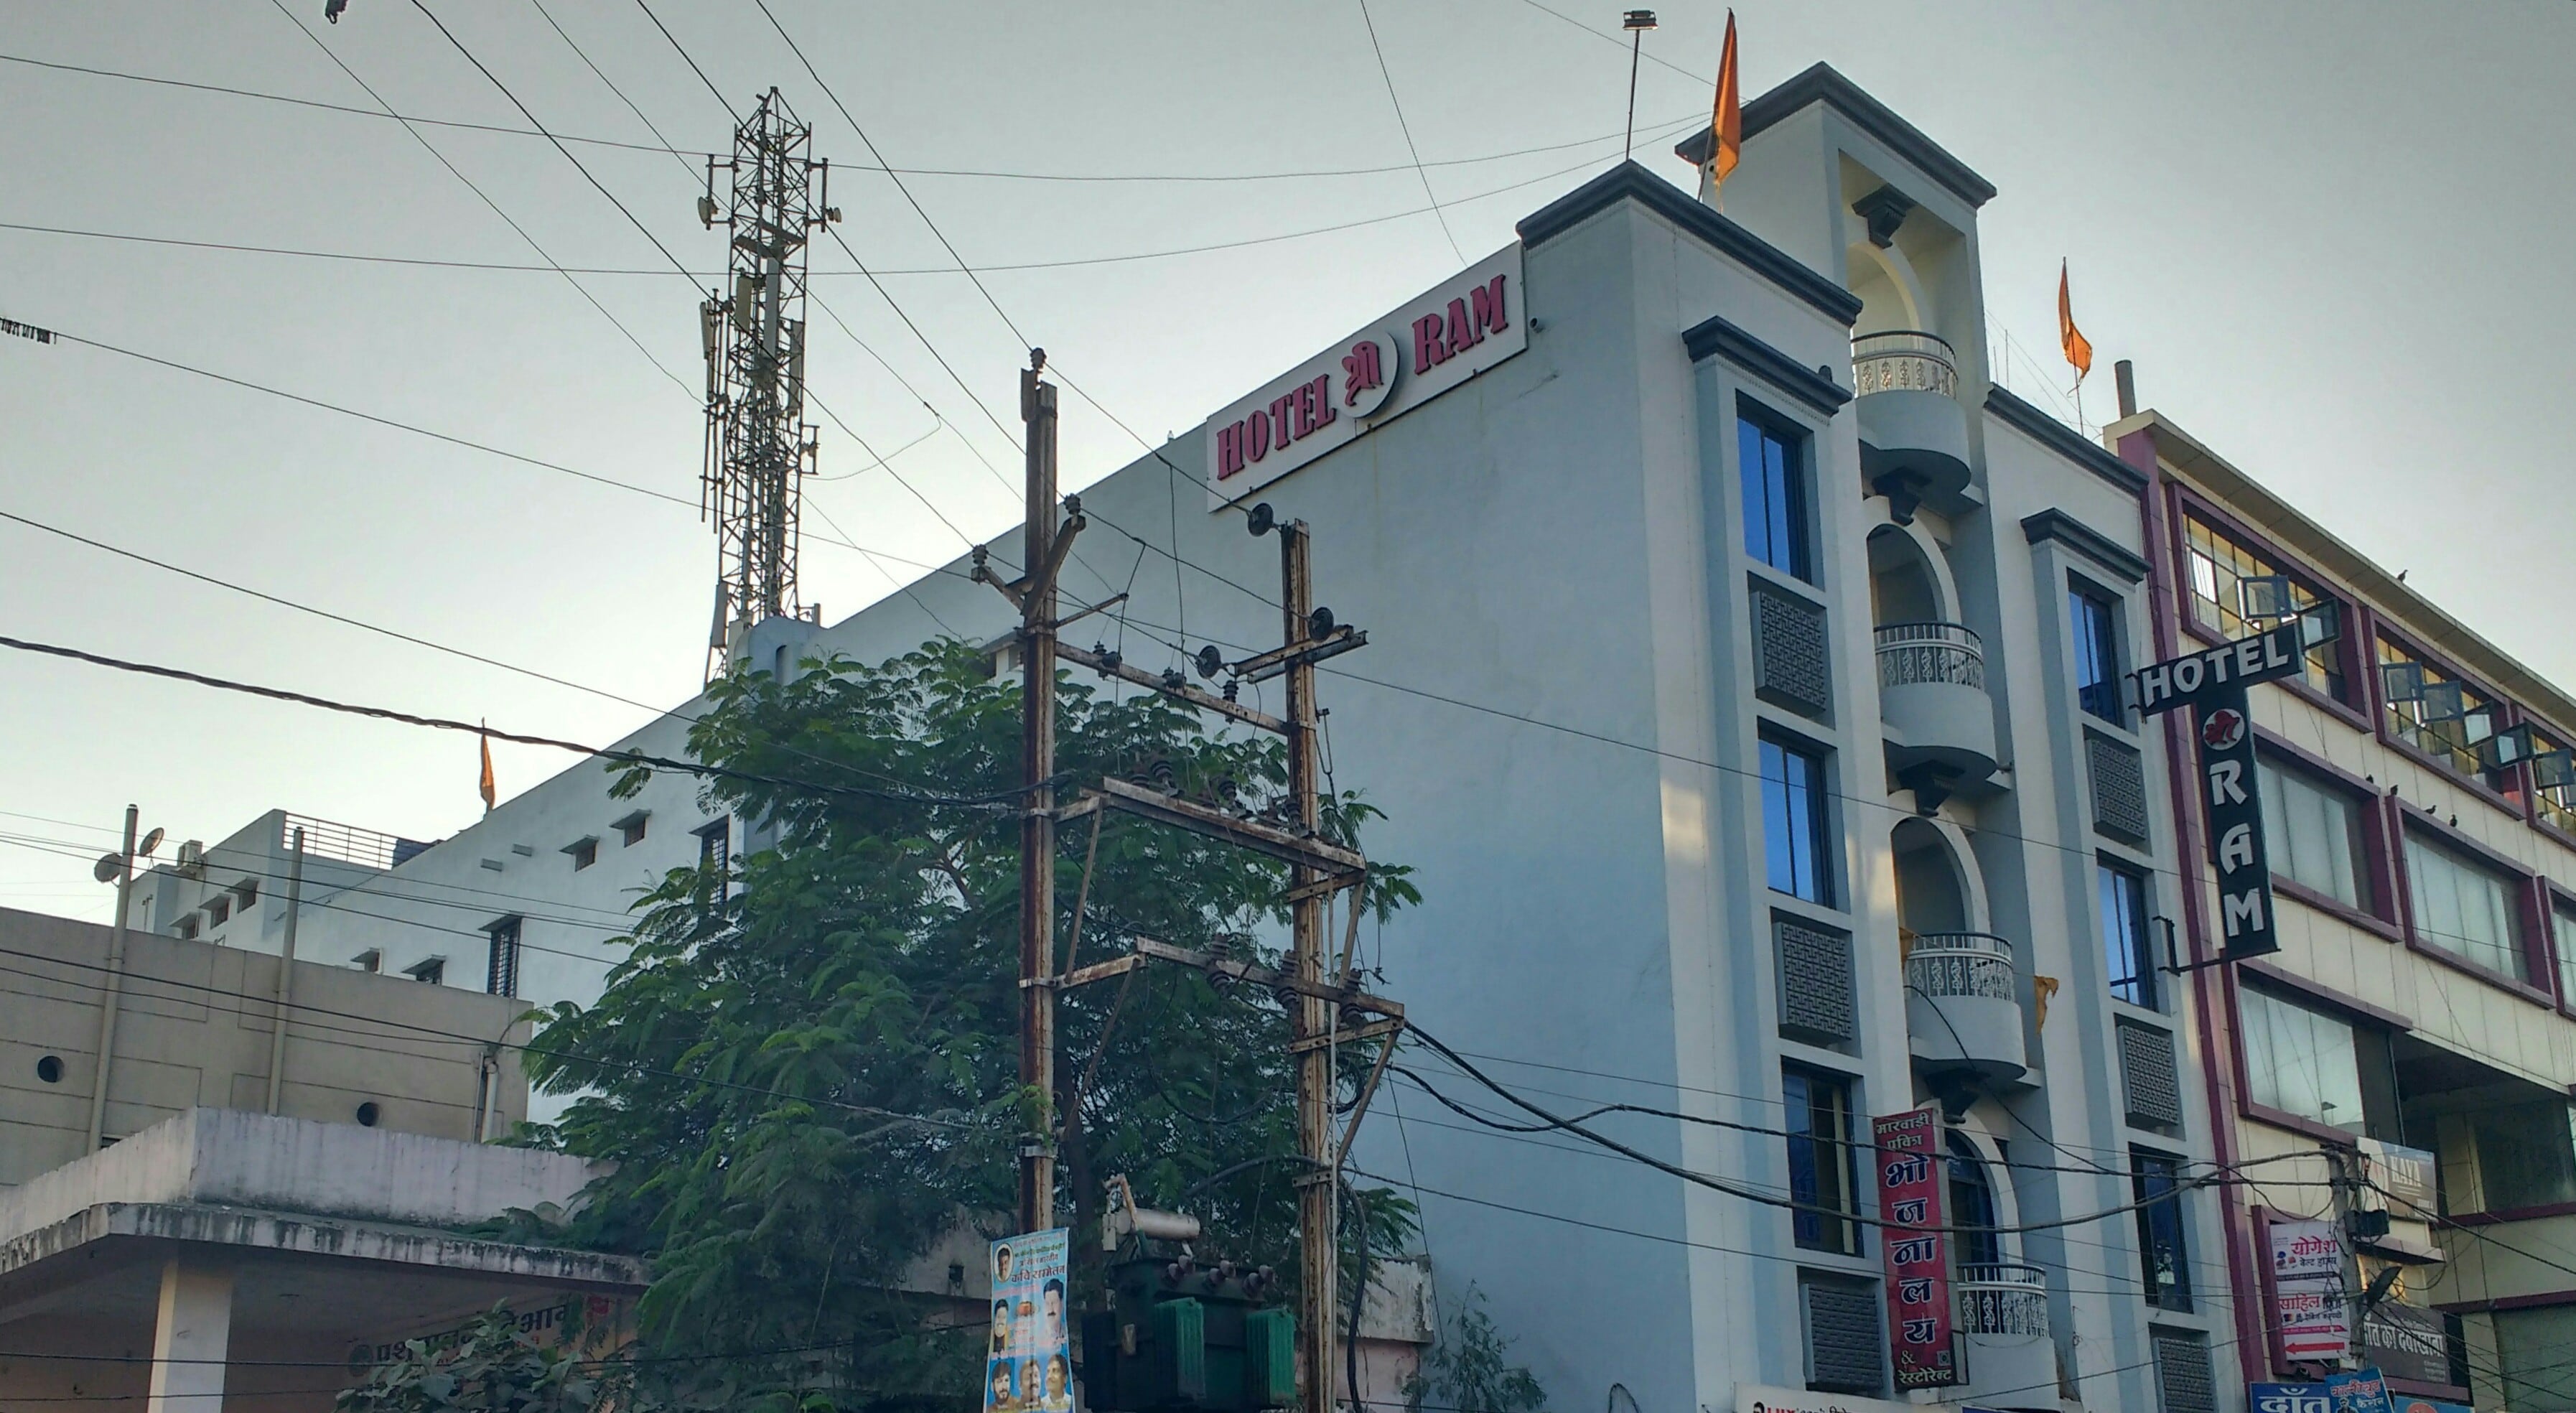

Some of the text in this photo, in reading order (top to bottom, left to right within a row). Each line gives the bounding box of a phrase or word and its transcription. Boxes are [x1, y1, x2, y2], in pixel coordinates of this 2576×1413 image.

[1217, 274, 1509, 480] HOTEL श्री RAM
[2142, 633, 2289, 707] HOTEL
[2209, 759, 2265, 936] RAM
[1876, 1112, 1930, 1134] मारवाड़ी
[1886, 1134, 1922, 1149] पवित्र
[2290, 1236, 2338, 1256] योगेश
[1901, 1350, 1916, 1364] &
